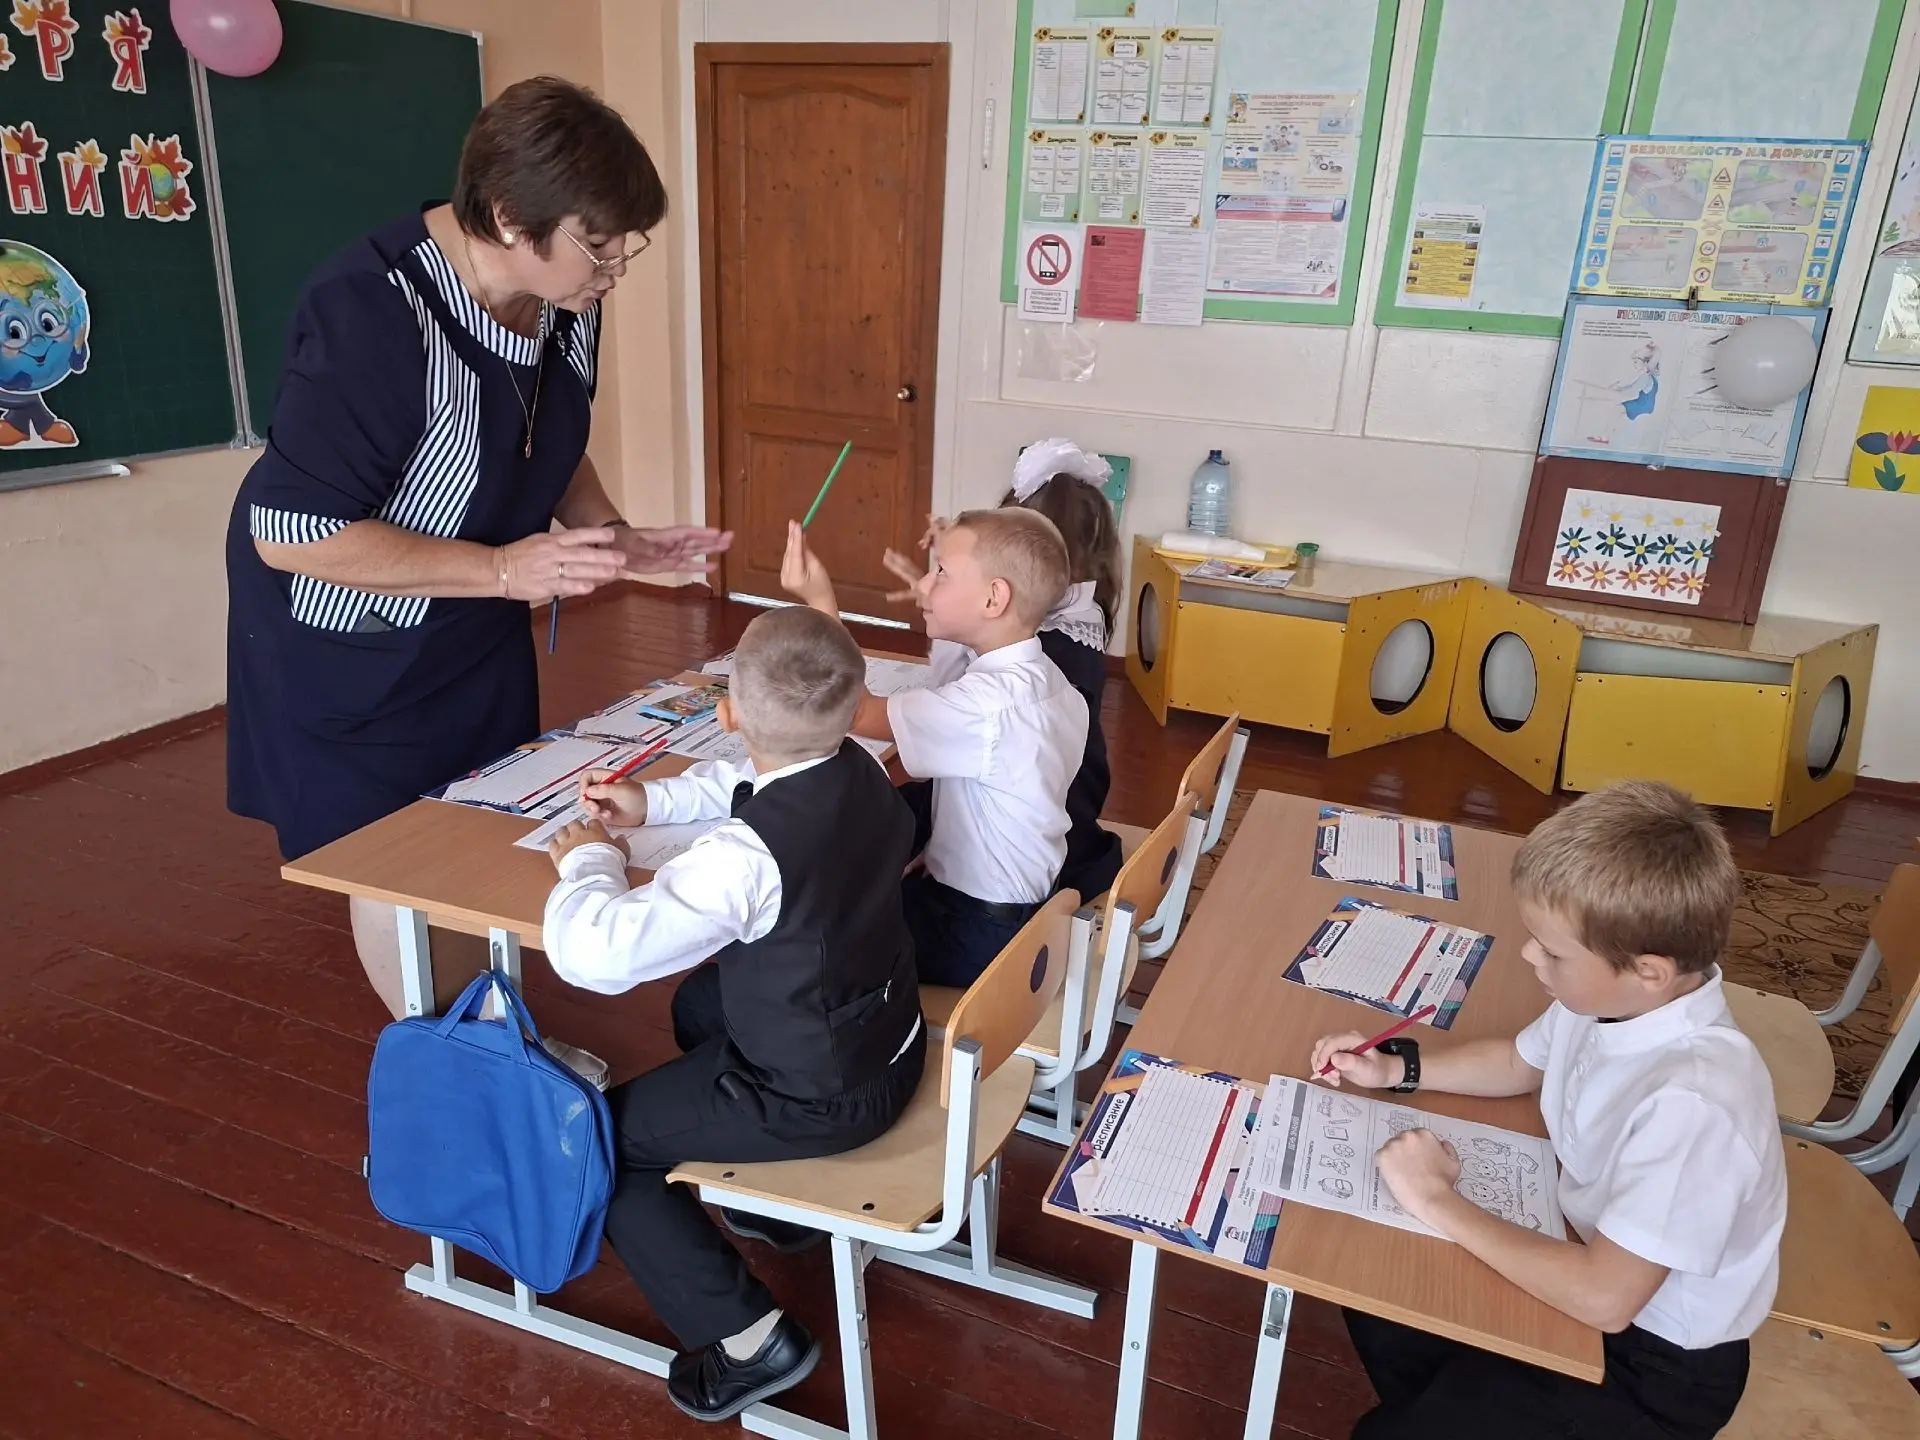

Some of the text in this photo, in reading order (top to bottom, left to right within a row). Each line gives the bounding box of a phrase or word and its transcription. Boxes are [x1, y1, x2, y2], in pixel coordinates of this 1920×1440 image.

[1629, 144, 1834, 160] БЕЗОПАСНОСТЬ НА ДОРОГЕ
[1616, 309, 1667, 323] ПИШИ
[1093, 1097, 1126, 1152] расписание
